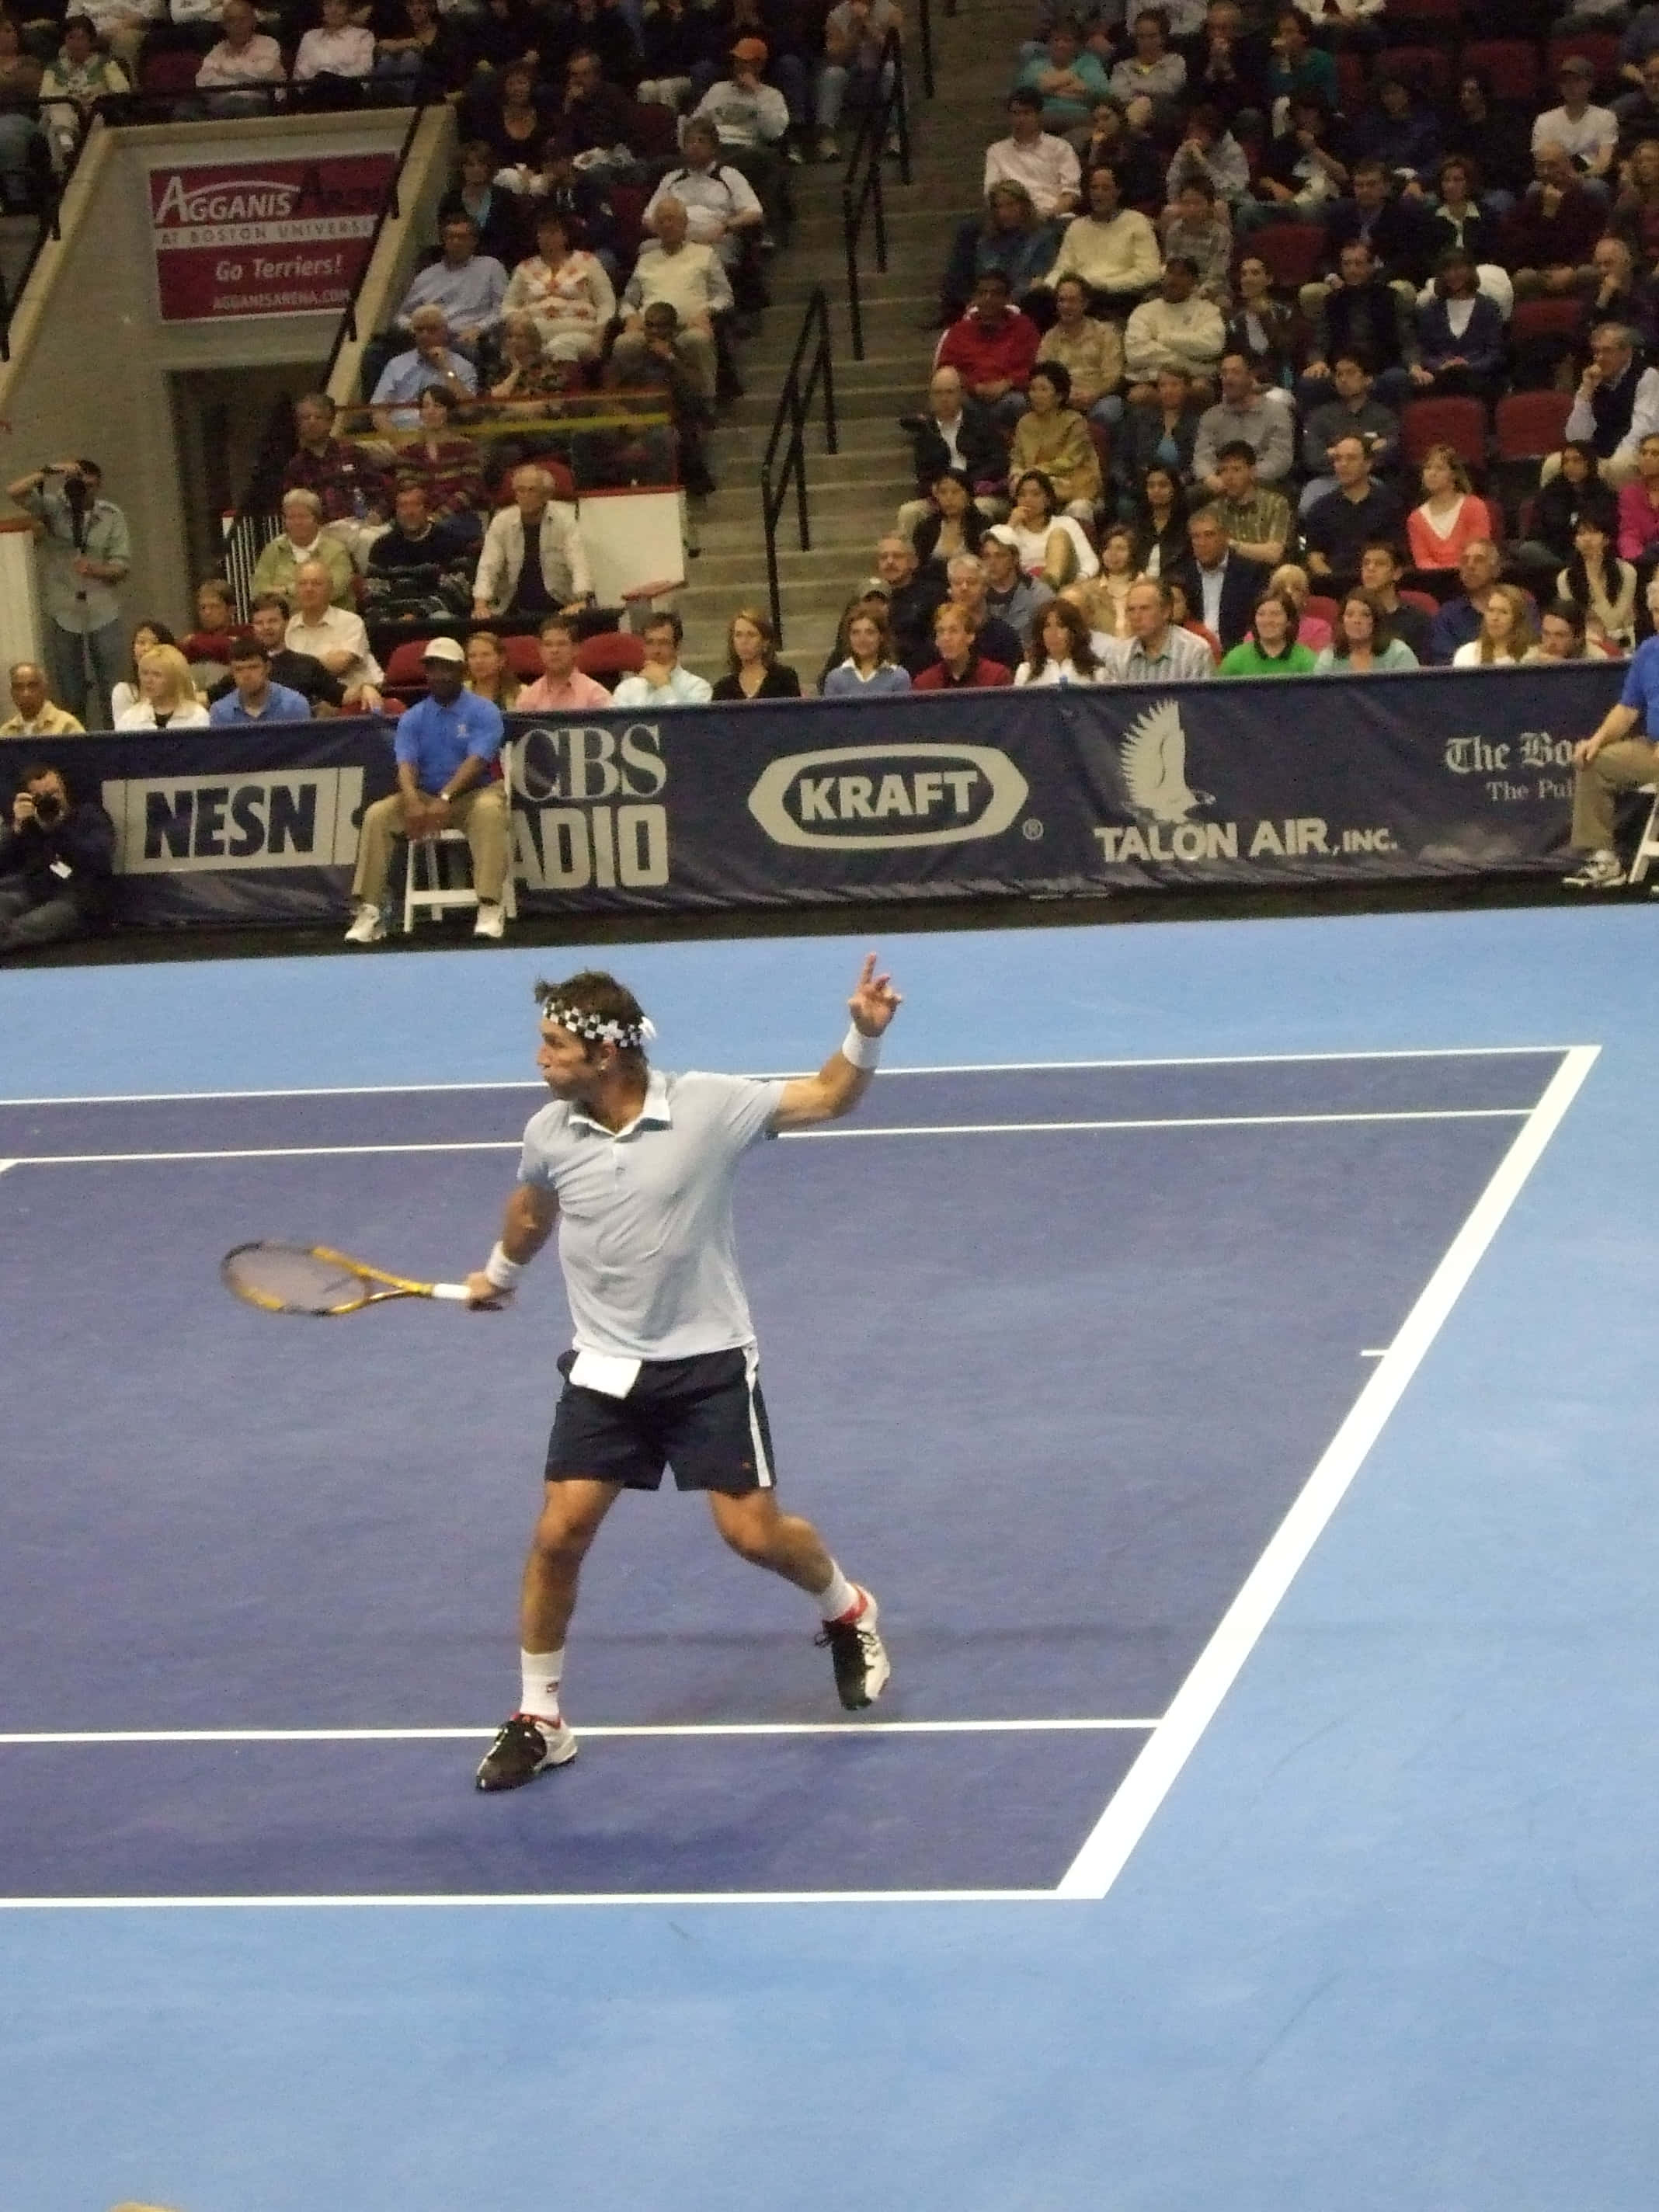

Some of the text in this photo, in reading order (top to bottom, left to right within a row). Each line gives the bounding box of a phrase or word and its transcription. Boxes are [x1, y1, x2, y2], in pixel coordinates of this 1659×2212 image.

[156, 176, 292, 224] AGGANIS
[162, 231, 177, 245] AT
[191, 226, 266, 243] BOSTON
[215, 254, 343, 281] Go Terriers!
[510, 724, 667, 802] CBS
[1445, 732, 1574, 774] The Bo
[800, 770, 977, 821] KRAFT
[1485, 780, 1529, 801] The
[144, 784, 317, 858] NESN
[1094, 822, 1239, 862] TALON
[1342, 828, 1398, 852] INC.
[509, 804, 670, 889] ADIO
